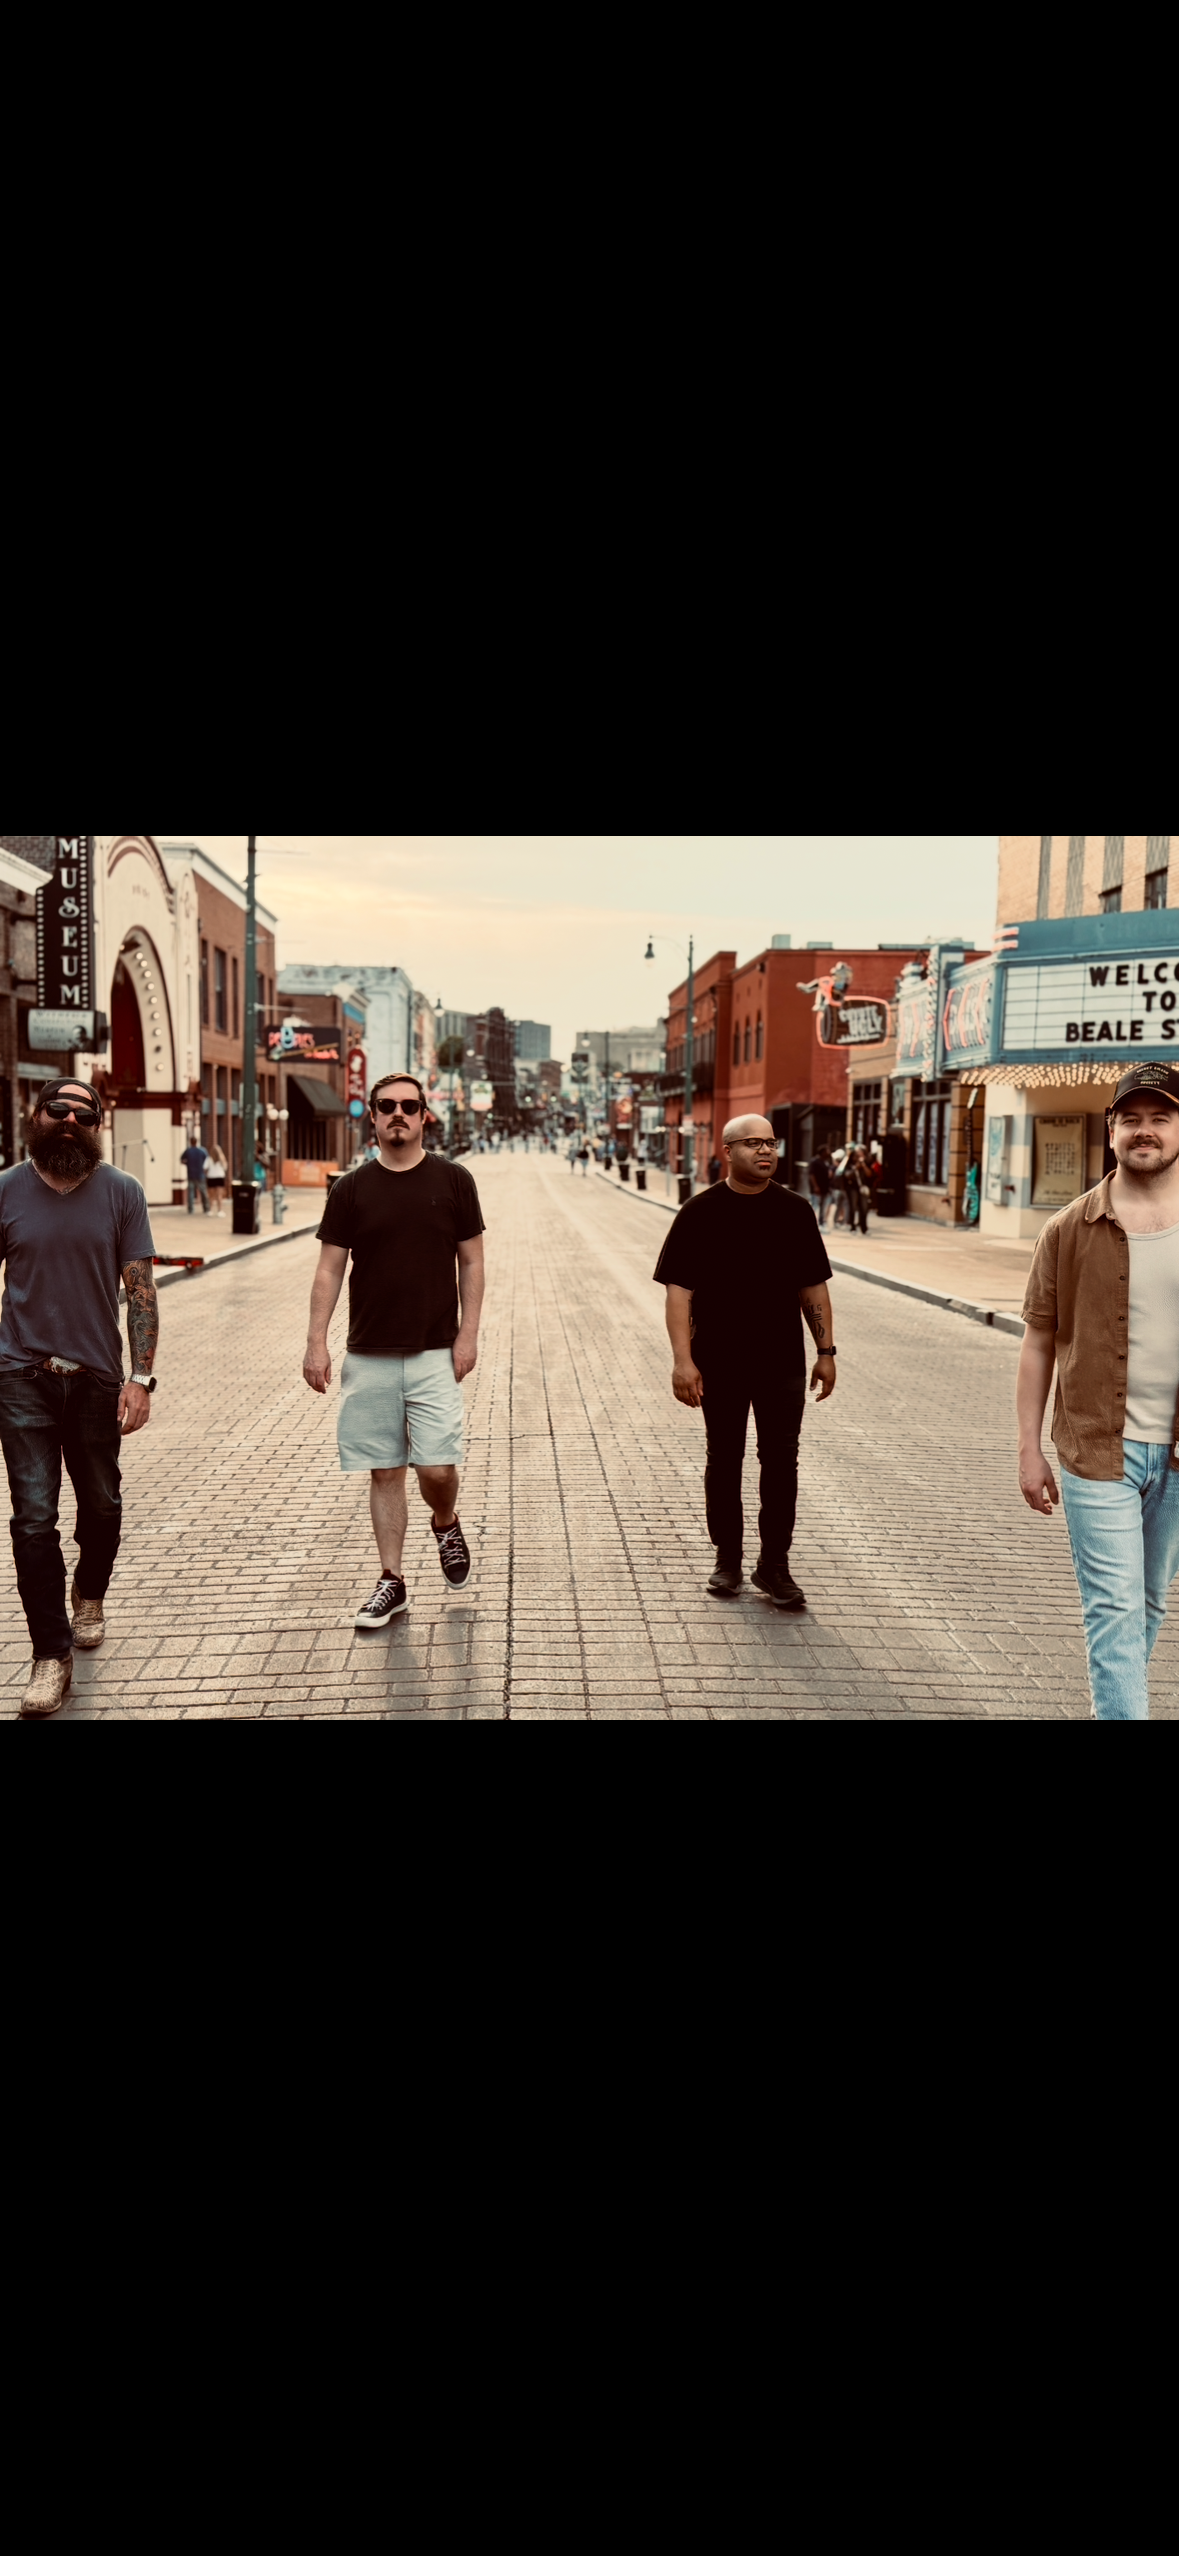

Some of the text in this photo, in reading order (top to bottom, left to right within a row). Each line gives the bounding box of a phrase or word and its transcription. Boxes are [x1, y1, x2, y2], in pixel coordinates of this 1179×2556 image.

[57, 838, 81, 1006] MUSEUM
[1142, 990, 1177, 1012] TO
[1065, 1018, 1179, 1043] BEALE S
